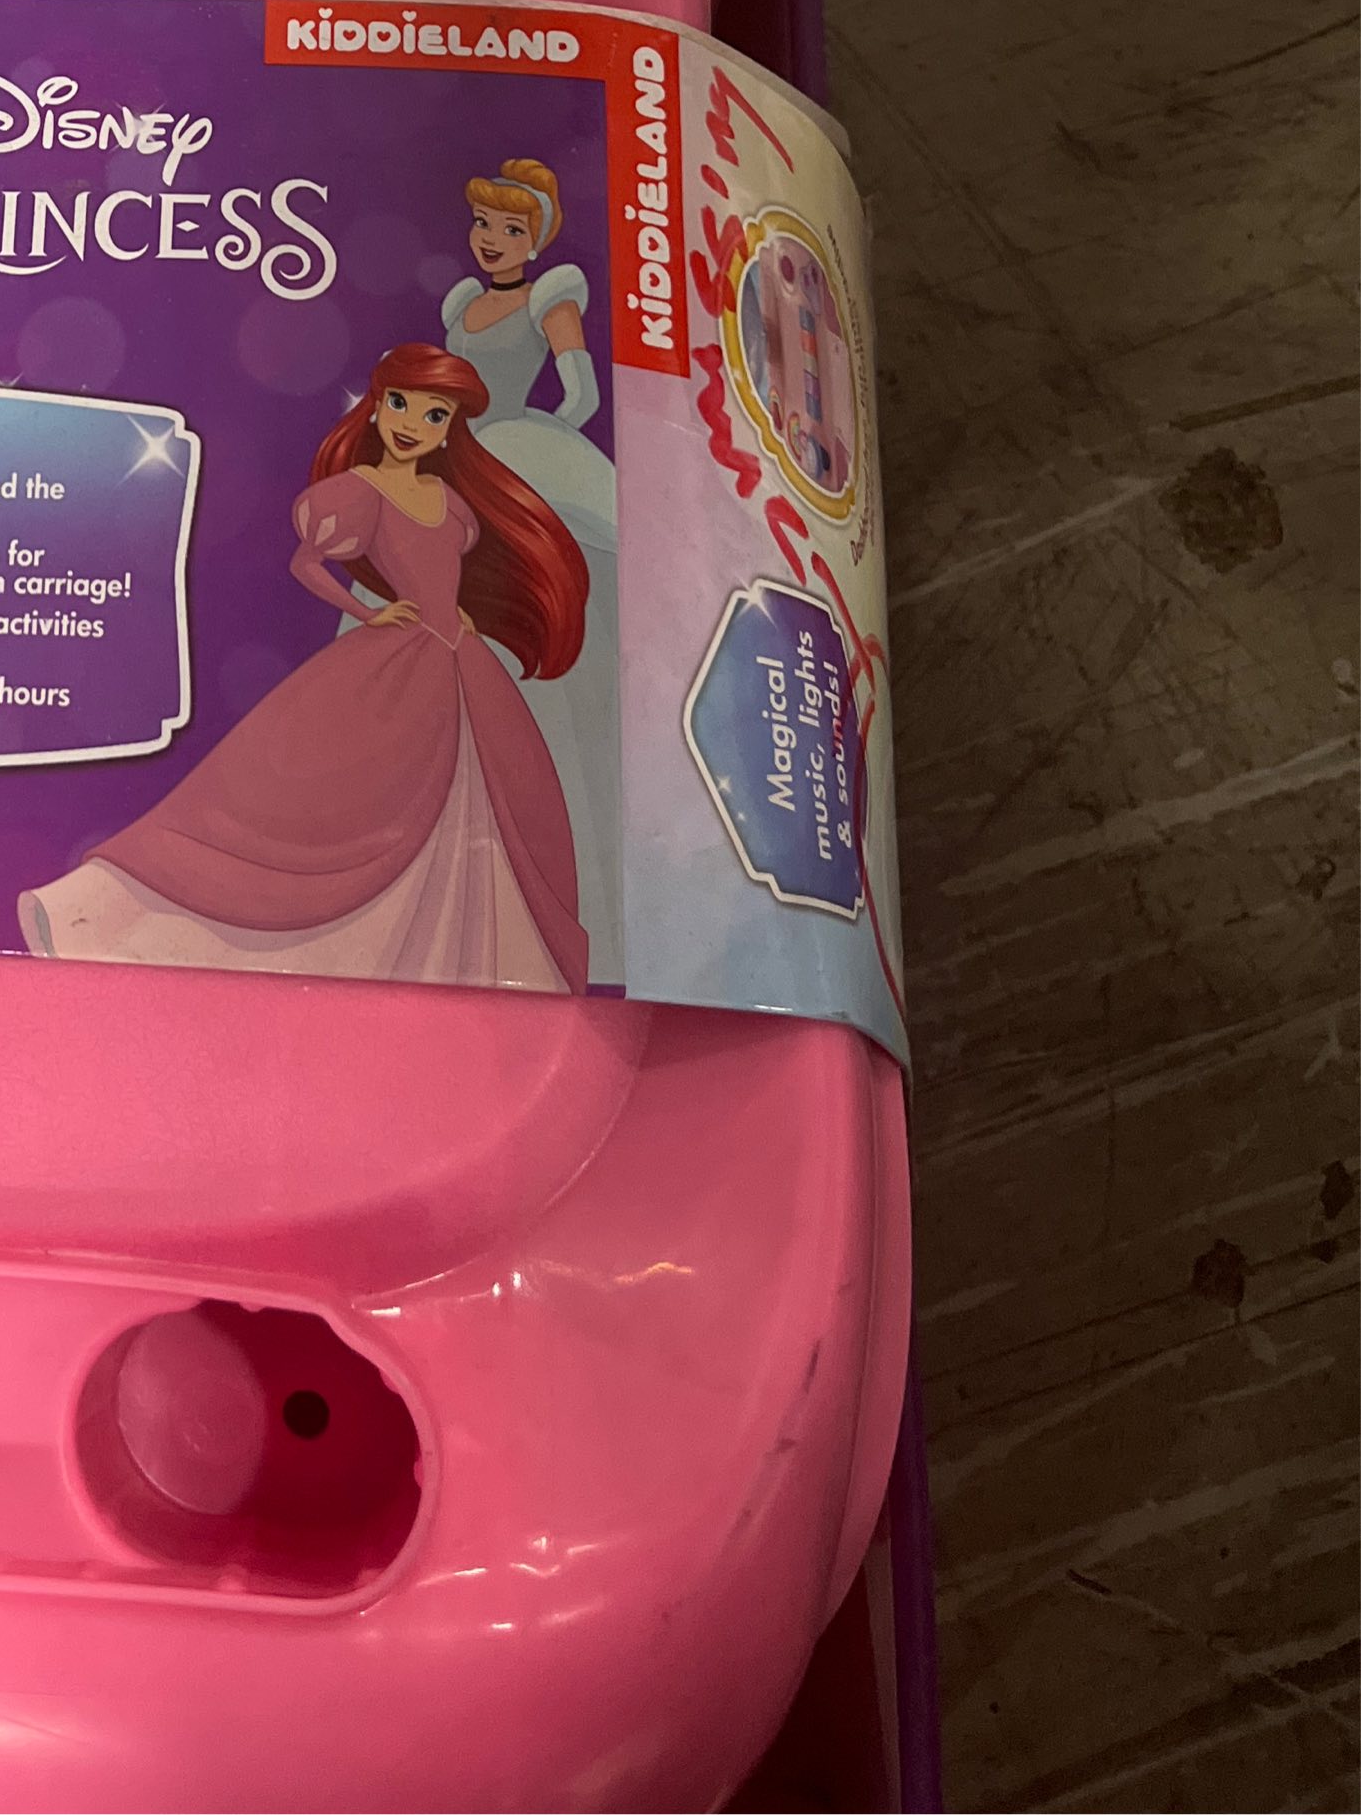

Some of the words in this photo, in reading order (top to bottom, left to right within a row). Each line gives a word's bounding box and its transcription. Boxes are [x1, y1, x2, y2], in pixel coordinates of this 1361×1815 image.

[26, 474, 65, 500] the
[8, 539, 45, 566] for
[14, 571, 131, 605] carriage!
[792, 630, 822, 728] lights
[756, 656, 796, 812] Magical
[823, 660, 849, 804] sounds!
[804, 744, 832, 861] music,
[837, 820, 851, 848] &
